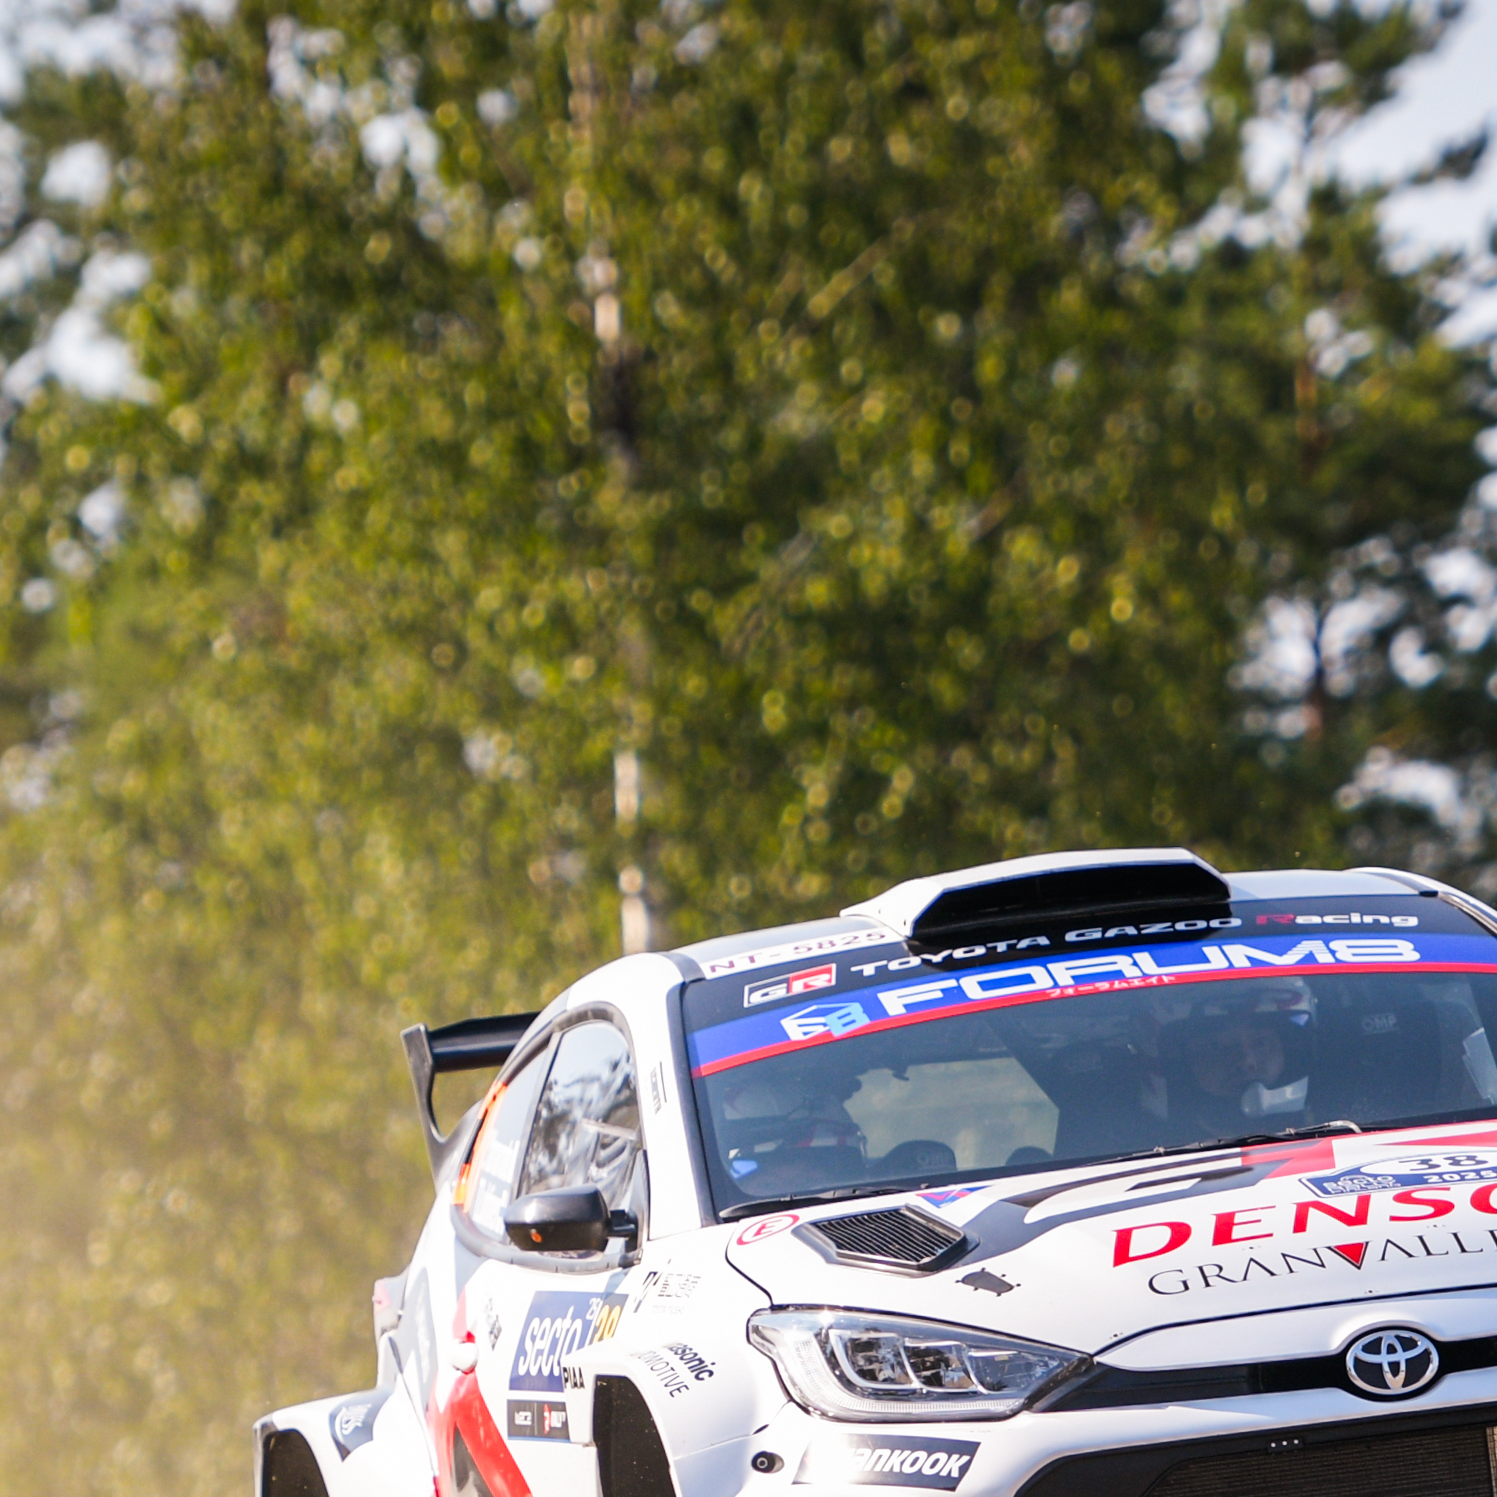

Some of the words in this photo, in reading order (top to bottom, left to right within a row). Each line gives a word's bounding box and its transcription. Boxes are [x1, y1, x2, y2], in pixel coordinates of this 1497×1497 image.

[850, 935, 1051, 977] TOYOTA
[1065, 917, 1243, 943] GAZOO
[1256, 912, 1419, 928] Racing
[878, 938, 1421, 1016] FORUM8
[1398, 1154, 1489, 1172] 38
[1423, 1169, 1497, 1183] 2025
[562, 1366, 586, 1390] PIAA
